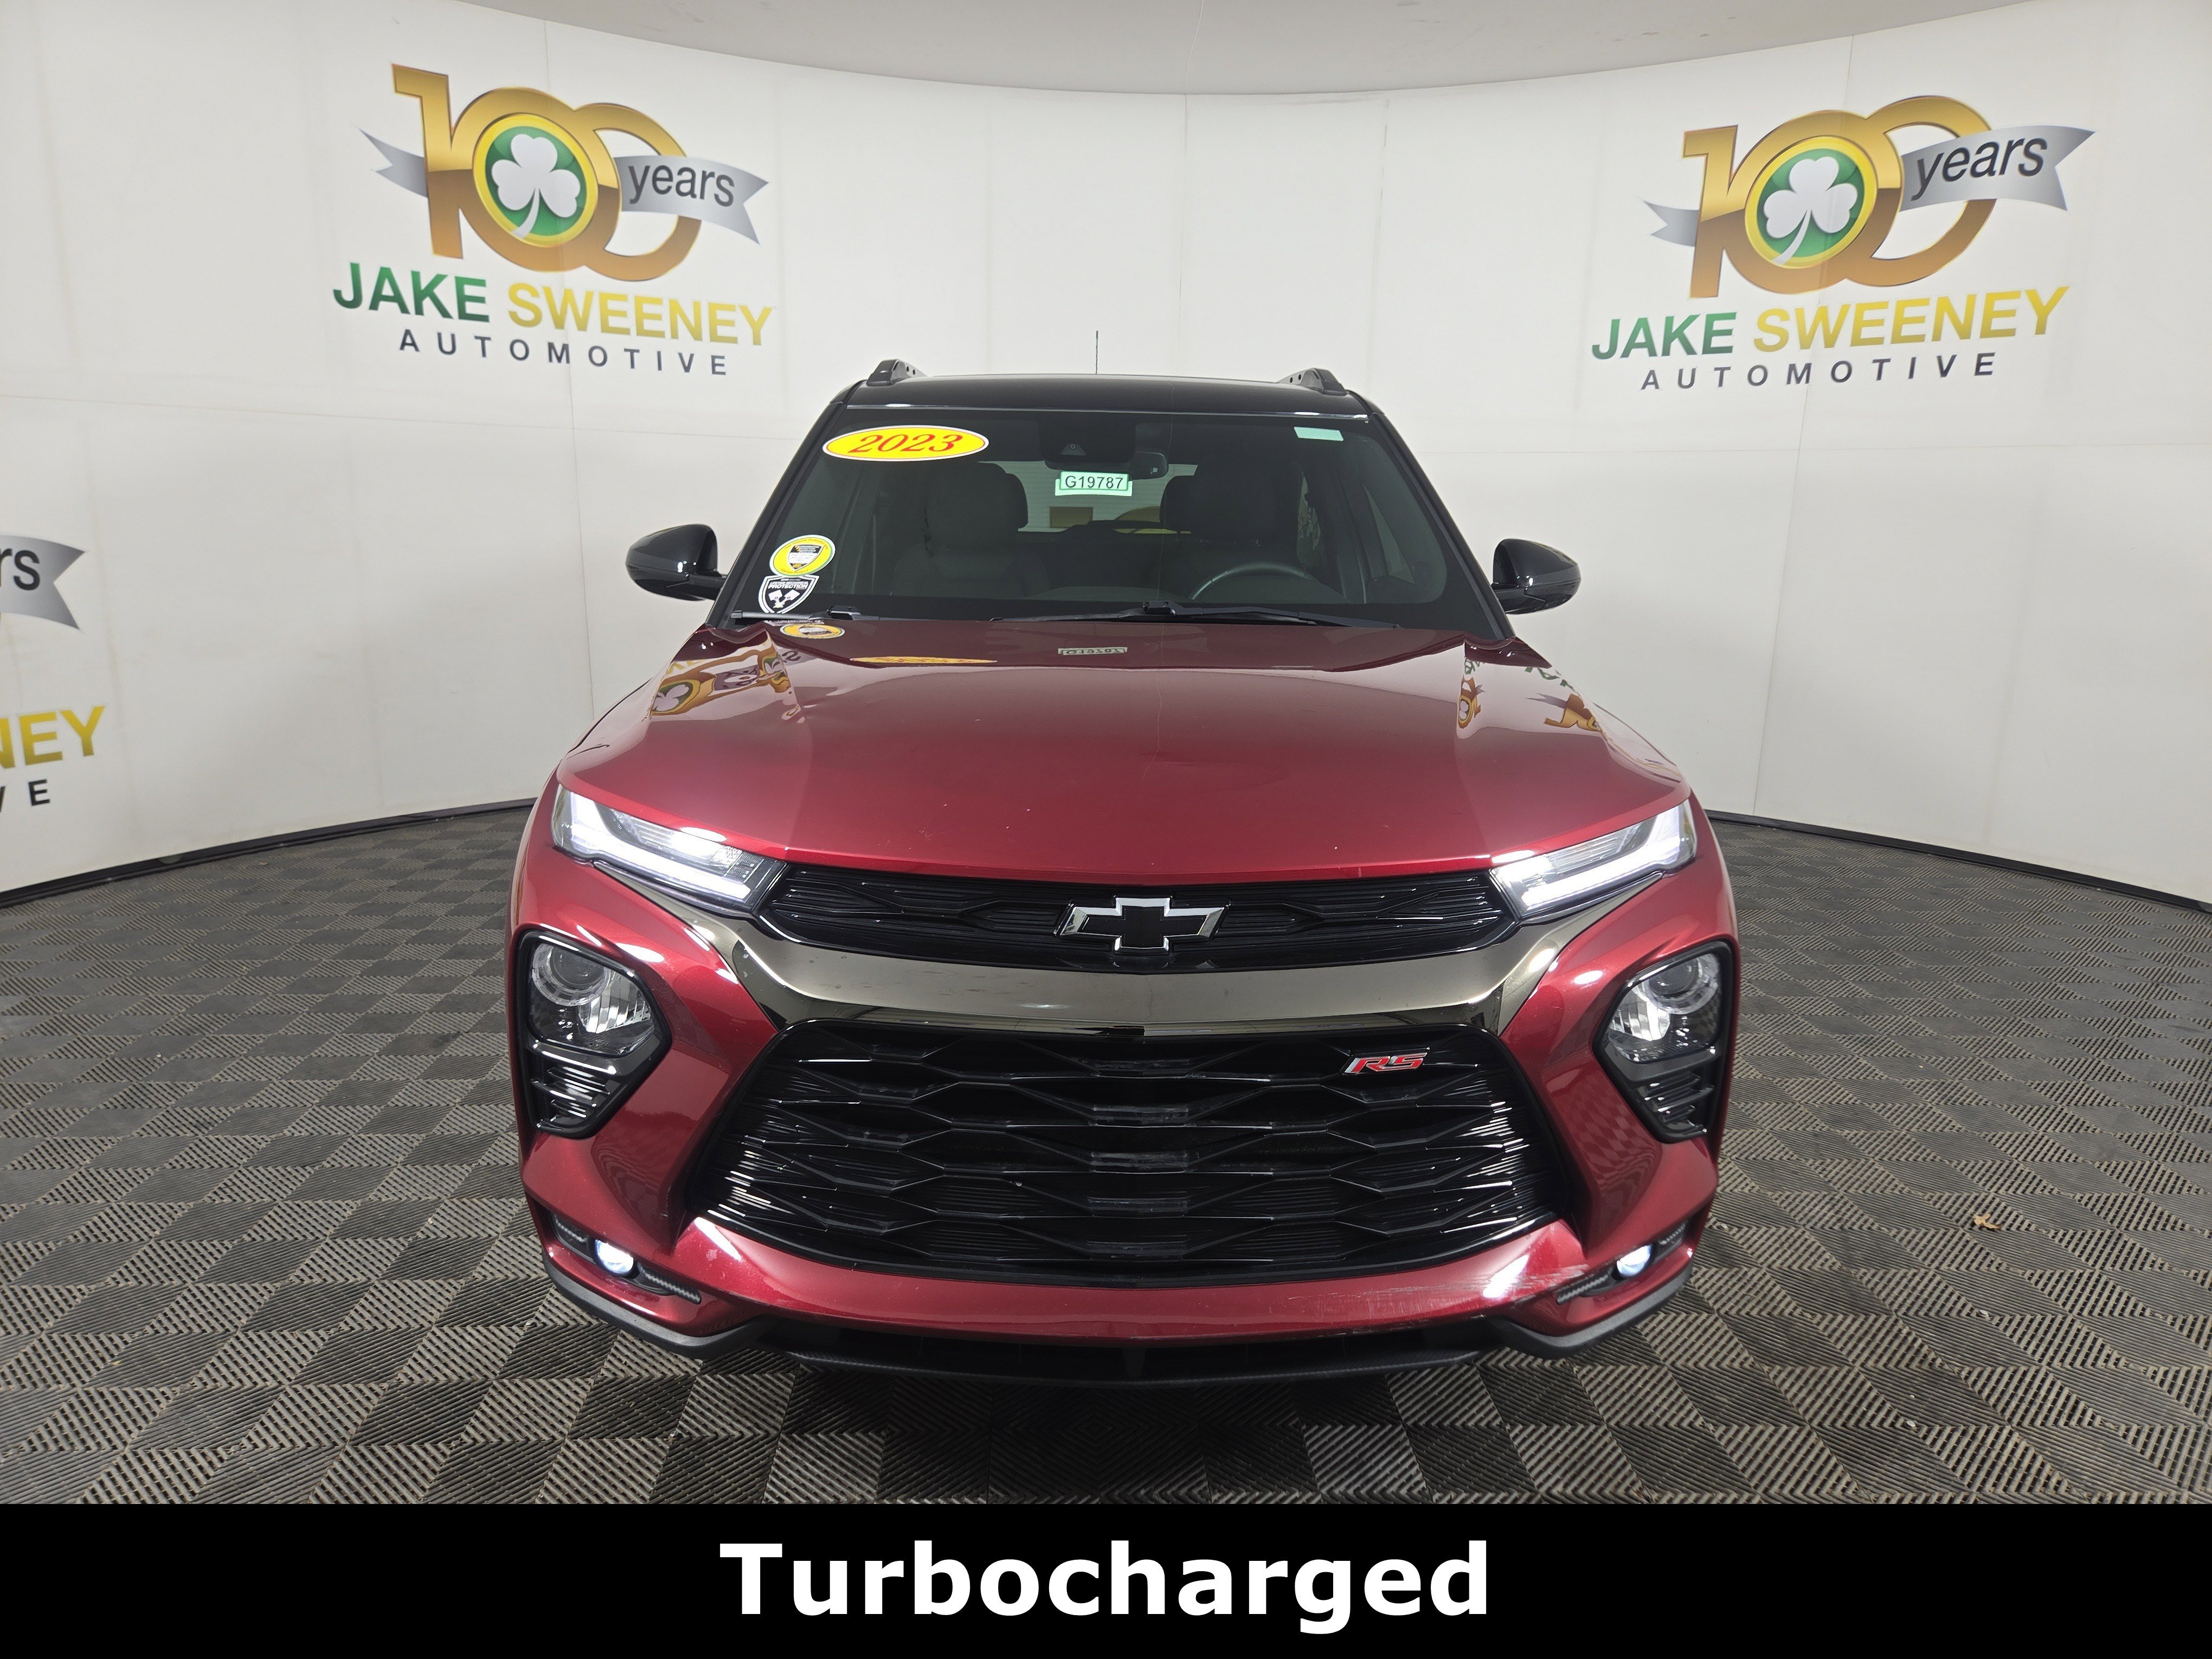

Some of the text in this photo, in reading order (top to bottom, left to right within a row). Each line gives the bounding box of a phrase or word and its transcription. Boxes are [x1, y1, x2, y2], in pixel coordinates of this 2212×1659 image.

[391, 63, 702, 282] 100
[628, 164, 735, 207] years
[1911, 137, 2048, 201] years
[1682, 95, 1997, 299] 100
[333, 261, 773, 346] JAKE SWEENEY
[1592, 285, 2070, 359] JAKE SWEENEY
[400, 329, 726, 376] AUTOMOTIVE
[1640, 352, 1996, 390] AUTOMOTIVE
[847, 434, 963, 453] 2023
[1065, 475, 1124, 489] G19787
[1344, 1052, 1428, 1074] RS
